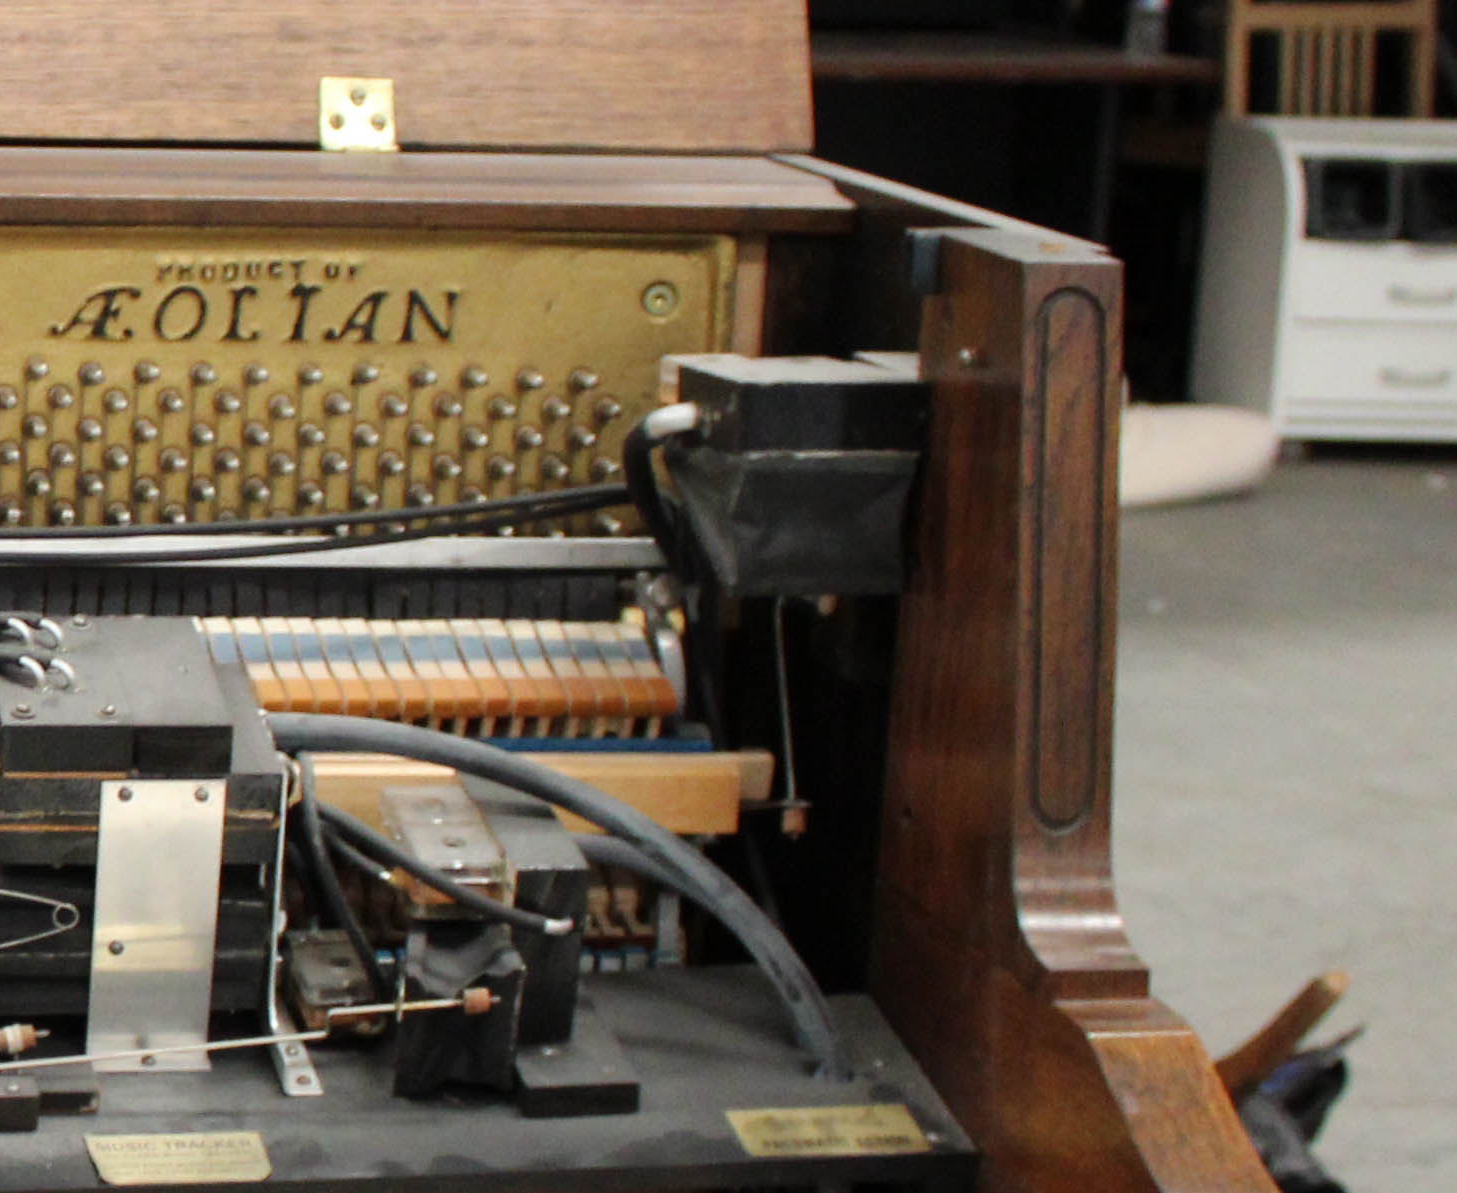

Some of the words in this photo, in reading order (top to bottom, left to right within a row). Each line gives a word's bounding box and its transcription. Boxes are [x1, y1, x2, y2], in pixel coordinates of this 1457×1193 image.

[156, 260, 308, 283] PRODUCT
[324, 264, 359, 281] OF
[46, 284, 464, 343] ÆOLIAN
[95, 1141, 151, 1151] MUSIC
[164, 1140, 252, 1150] TRACKER
